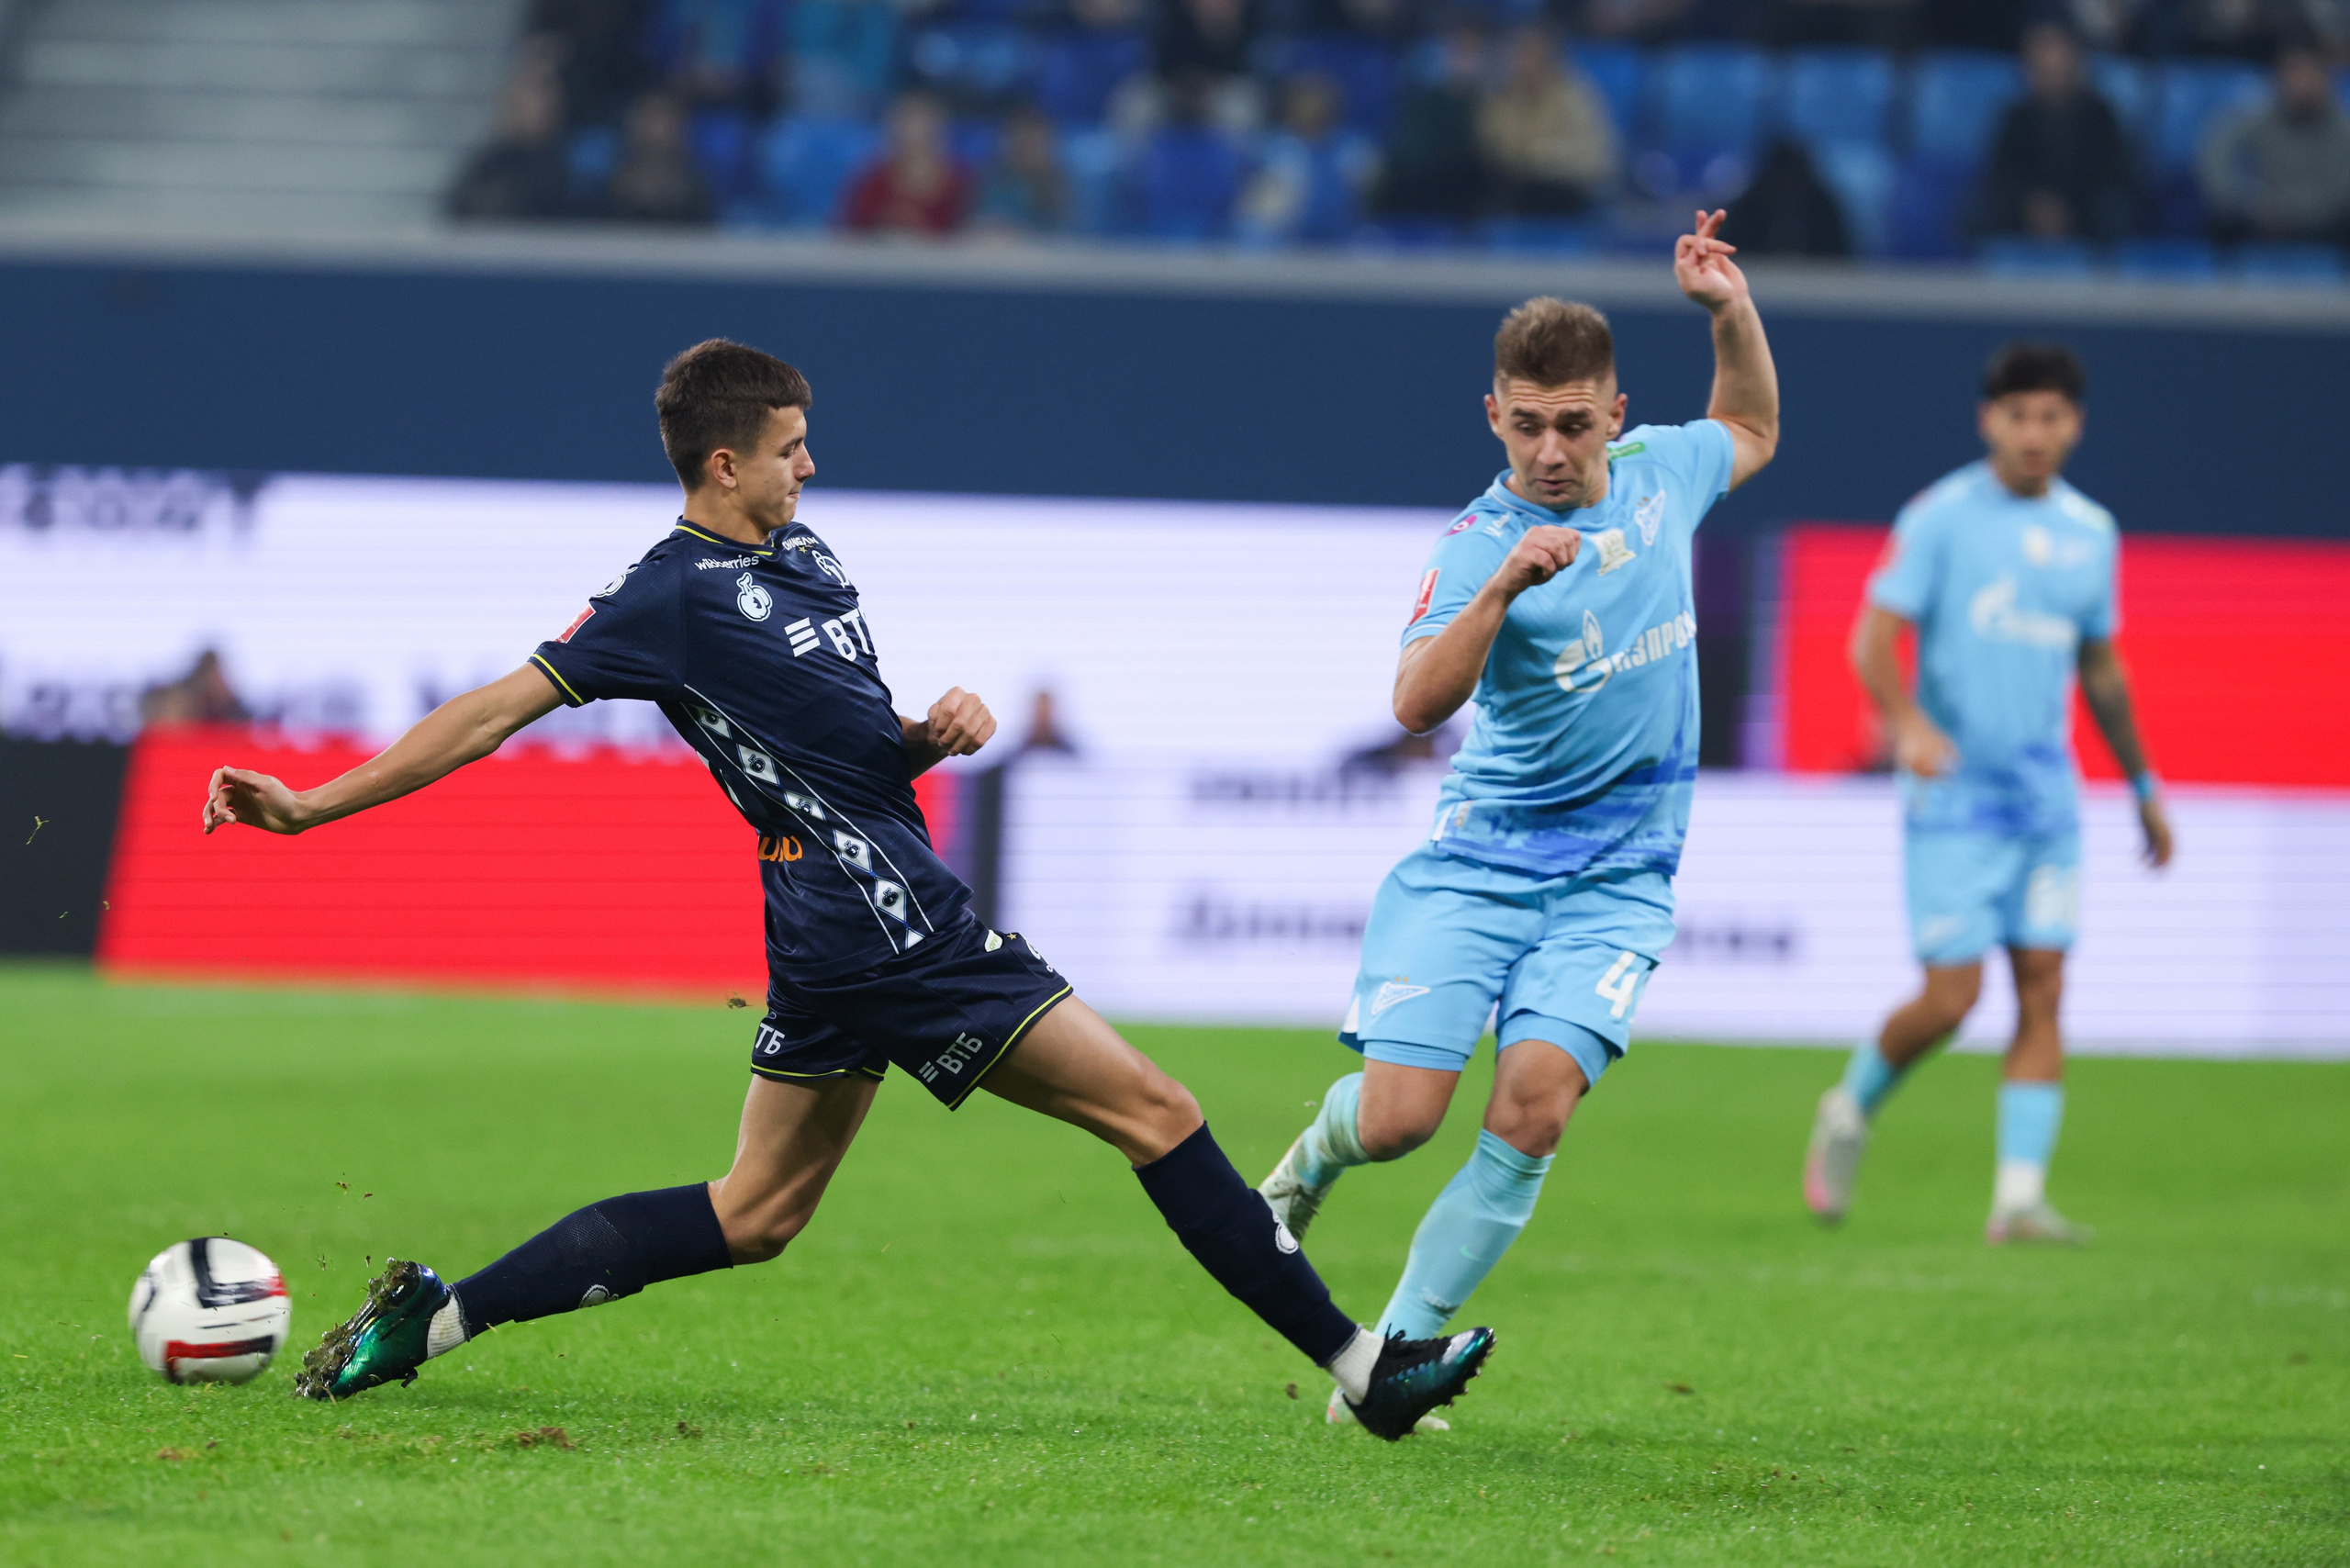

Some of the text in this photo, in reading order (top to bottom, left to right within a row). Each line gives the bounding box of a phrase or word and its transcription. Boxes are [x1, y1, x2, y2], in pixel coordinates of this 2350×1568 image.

[694, 554, 760, 571] wildberries
[821, 608, 872, 662] ВТ
[1595, 950, 1639, 1019] 4
[755, 1022, 786, 1055] ТБ
[935, 1031, 983, 1075] ВТБ
